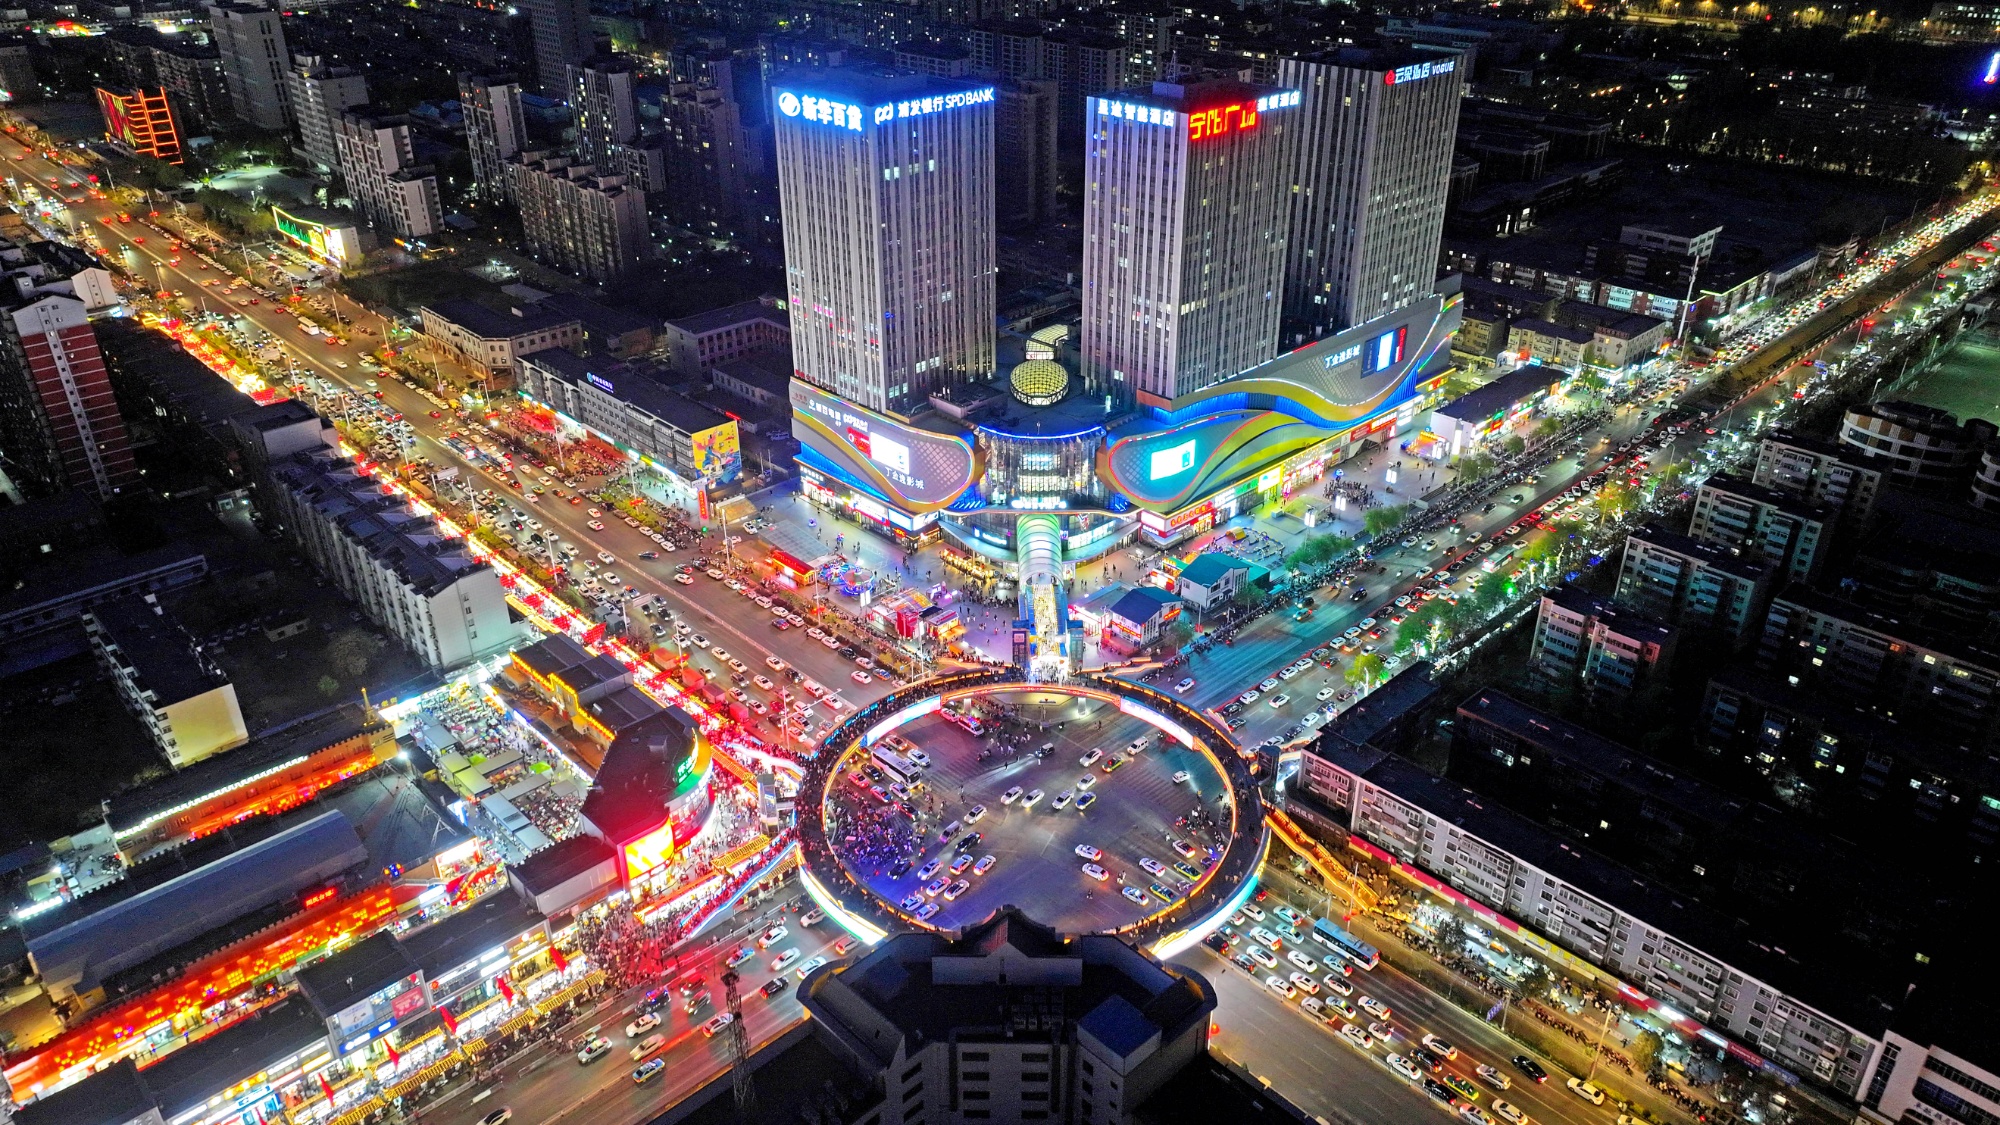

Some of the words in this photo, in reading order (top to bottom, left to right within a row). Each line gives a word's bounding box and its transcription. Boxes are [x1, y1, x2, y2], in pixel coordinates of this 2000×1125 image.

[801, 94, 863, 132] 新华百货
[897, 95, 943, 118] 浦发银行
[945, 93, 965, 108] SPD
[965, 87, 994, 105] BANK
